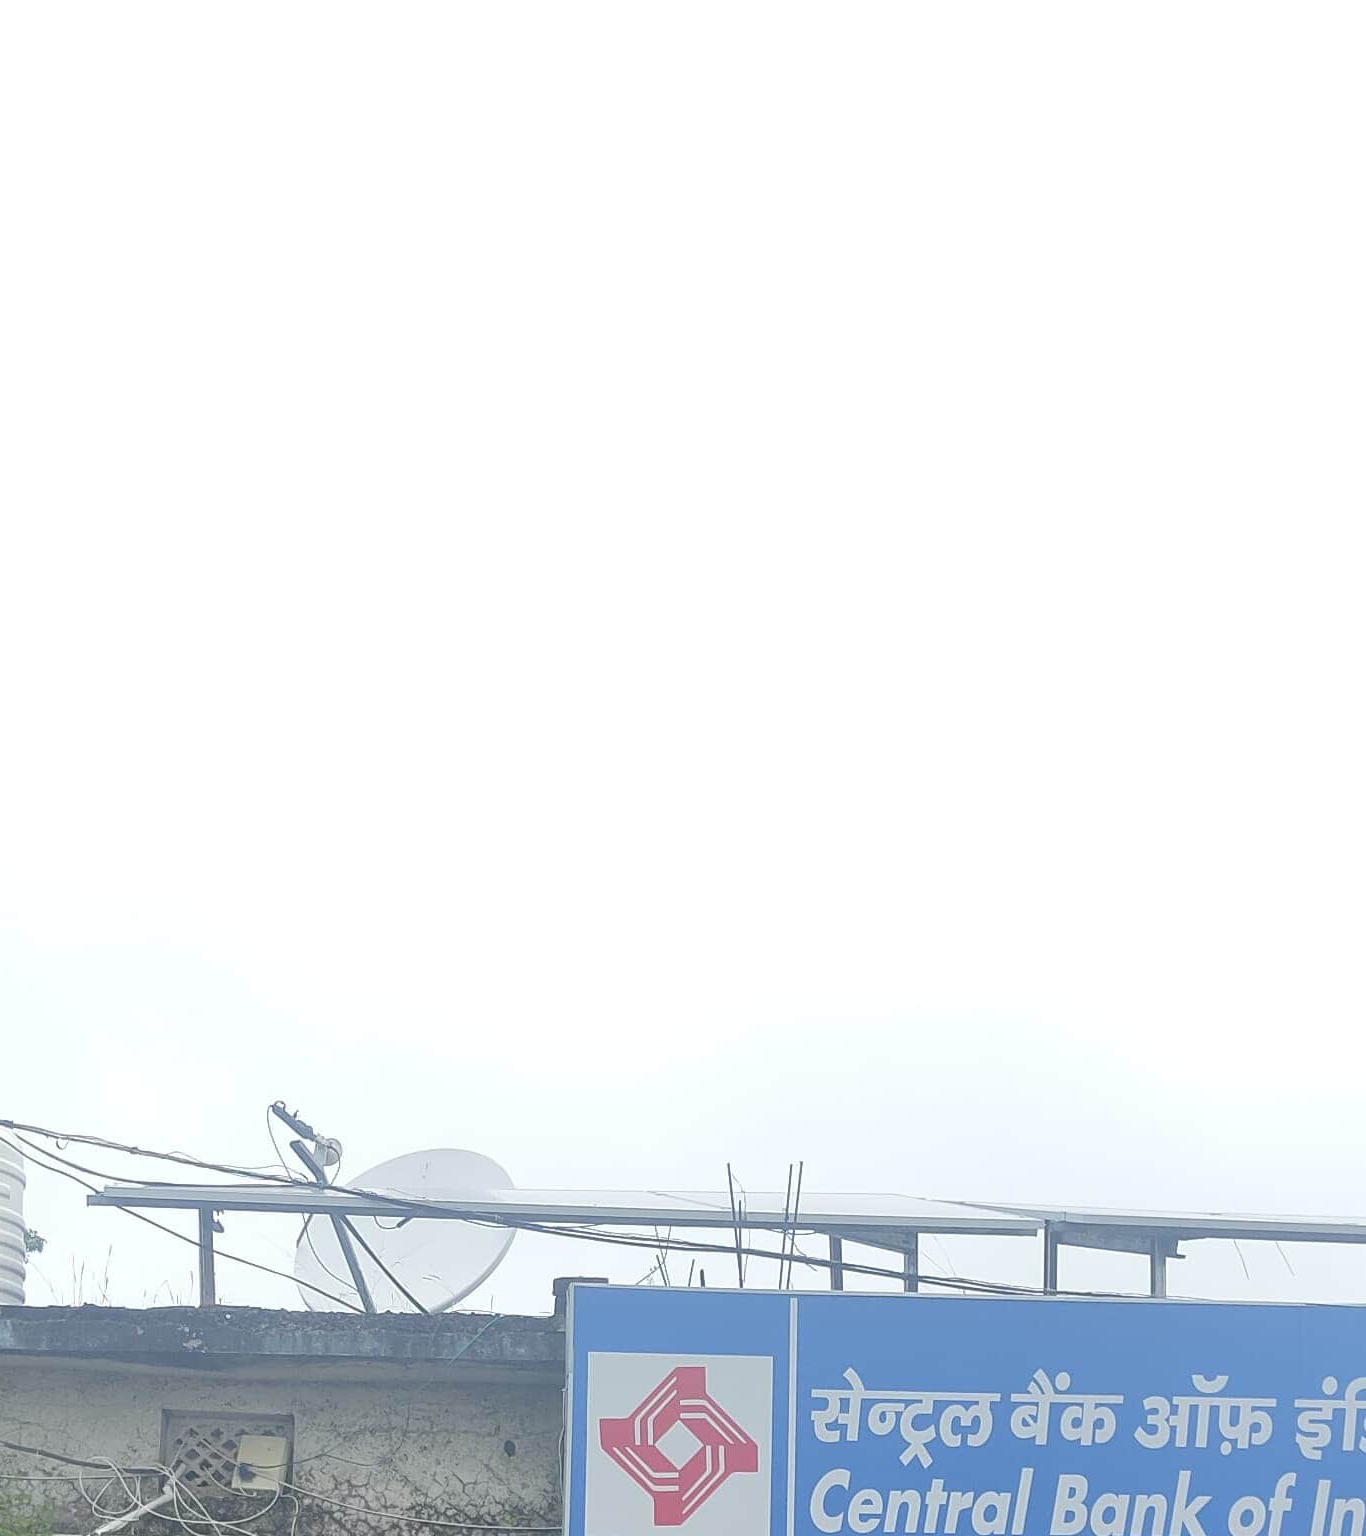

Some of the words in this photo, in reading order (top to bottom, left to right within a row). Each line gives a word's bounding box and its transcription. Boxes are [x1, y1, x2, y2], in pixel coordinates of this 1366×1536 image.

[811, 1367, 1001, 1467] सेन्ट्रल
[1011, 1369, 1124, 1446] बैंक
[810, 1466, 1033, 1536] Central
